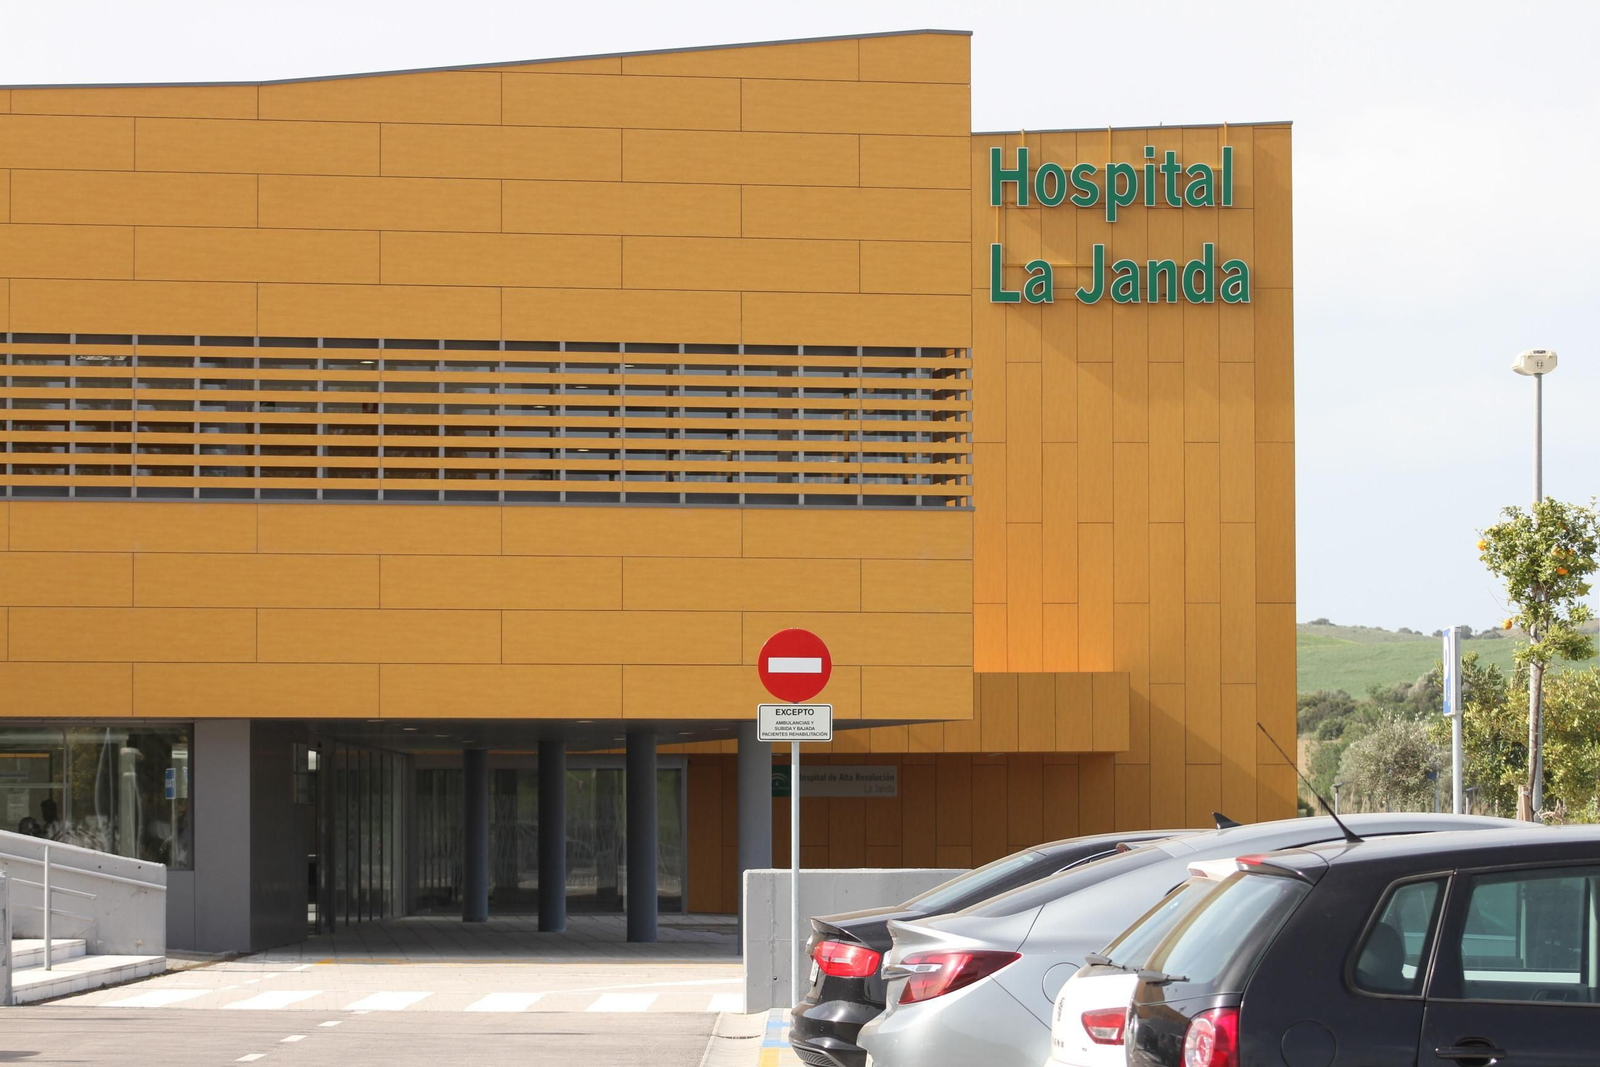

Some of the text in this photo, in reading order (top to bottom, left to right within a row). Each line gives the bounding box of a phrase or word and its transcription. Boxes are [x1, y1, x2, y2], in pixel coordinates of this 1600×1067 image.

[990, 146, 1233, 223] Hospital
[990, 242, 1251, 305] La Janda
[775, 708, 815, 716] EXCEPTO
[828, 773, 837, 781] de
[838, 773, 854, 781] Alta
[855, 773, 895, 781] Resolución
[863, 784, 895, 793] La Janda
